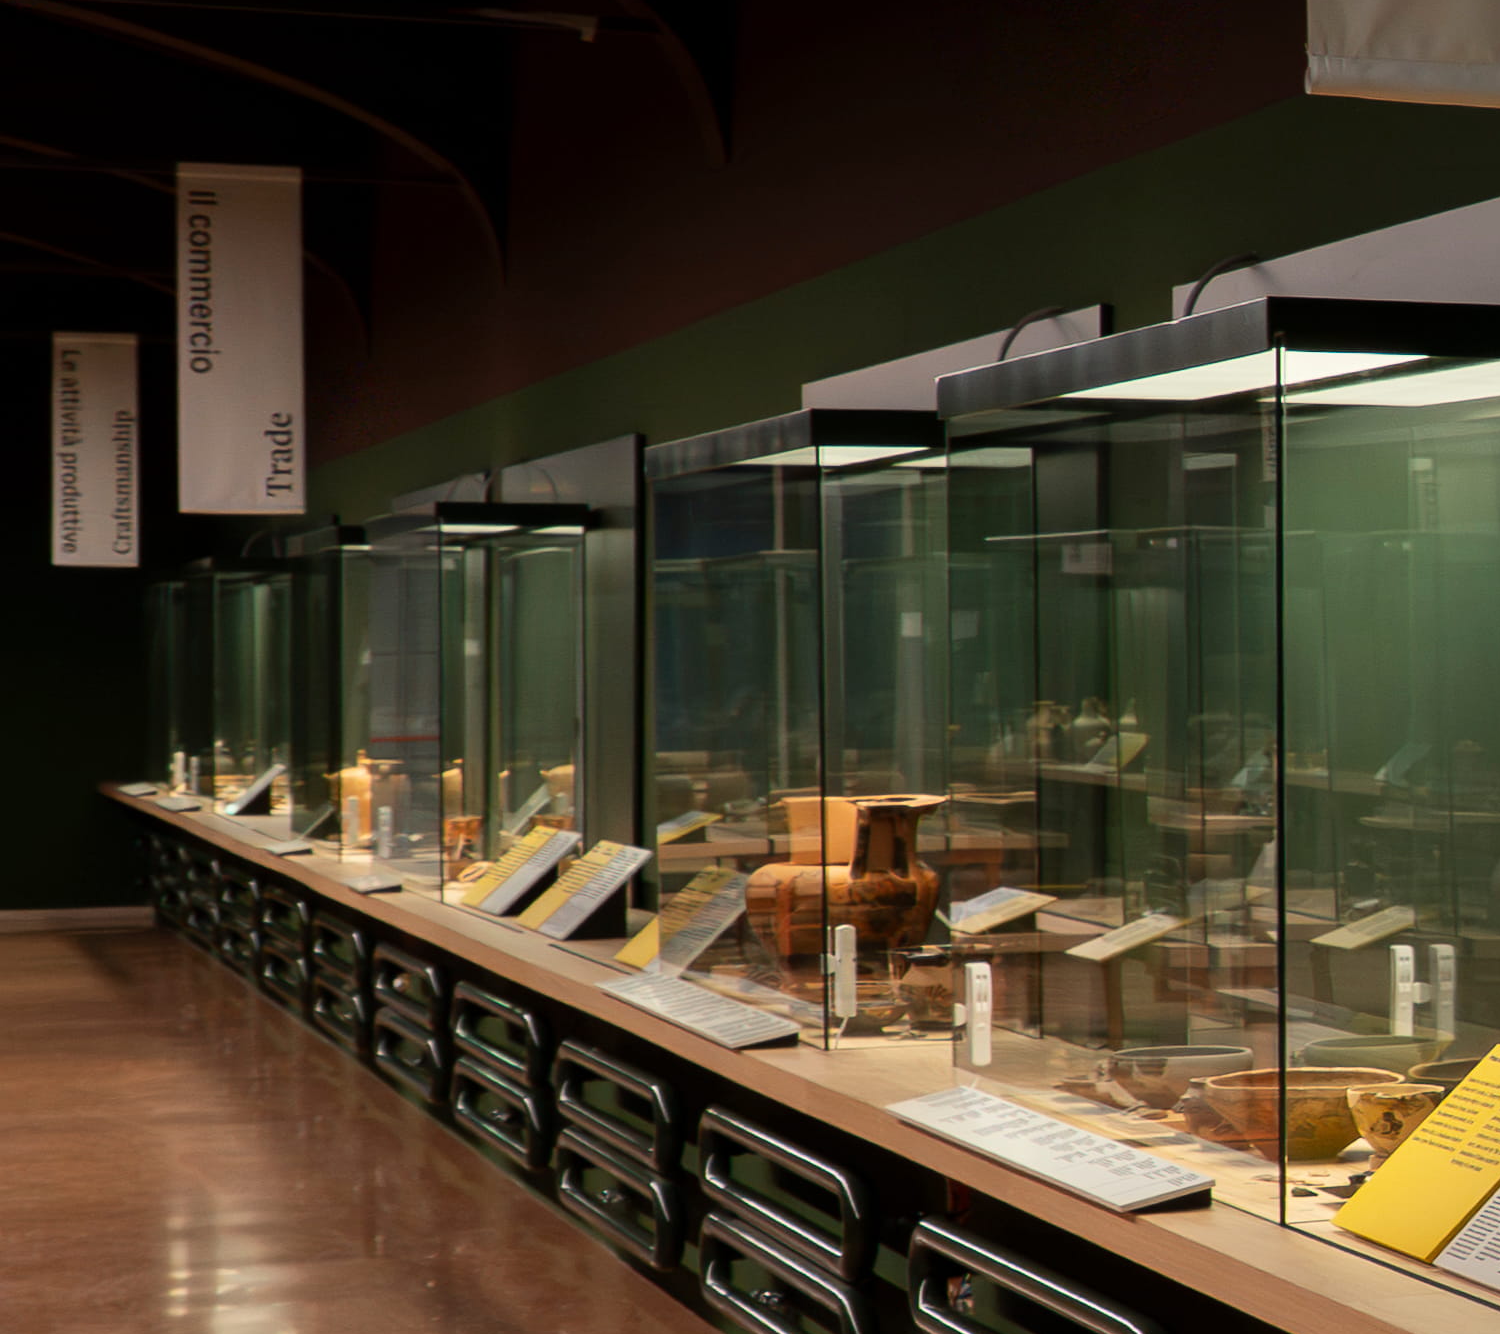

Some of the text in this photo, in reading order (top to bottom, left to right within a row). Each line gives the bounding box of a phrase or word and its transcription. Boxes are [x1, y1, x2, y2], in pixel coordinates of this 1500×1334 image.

[188, 190, 222, 375] Il commercio
[57, 348, 84, 554] Le attività produttive
[112, 409, 136, 555] Craftsmanship
[264, 412, 294, 498] Trade
